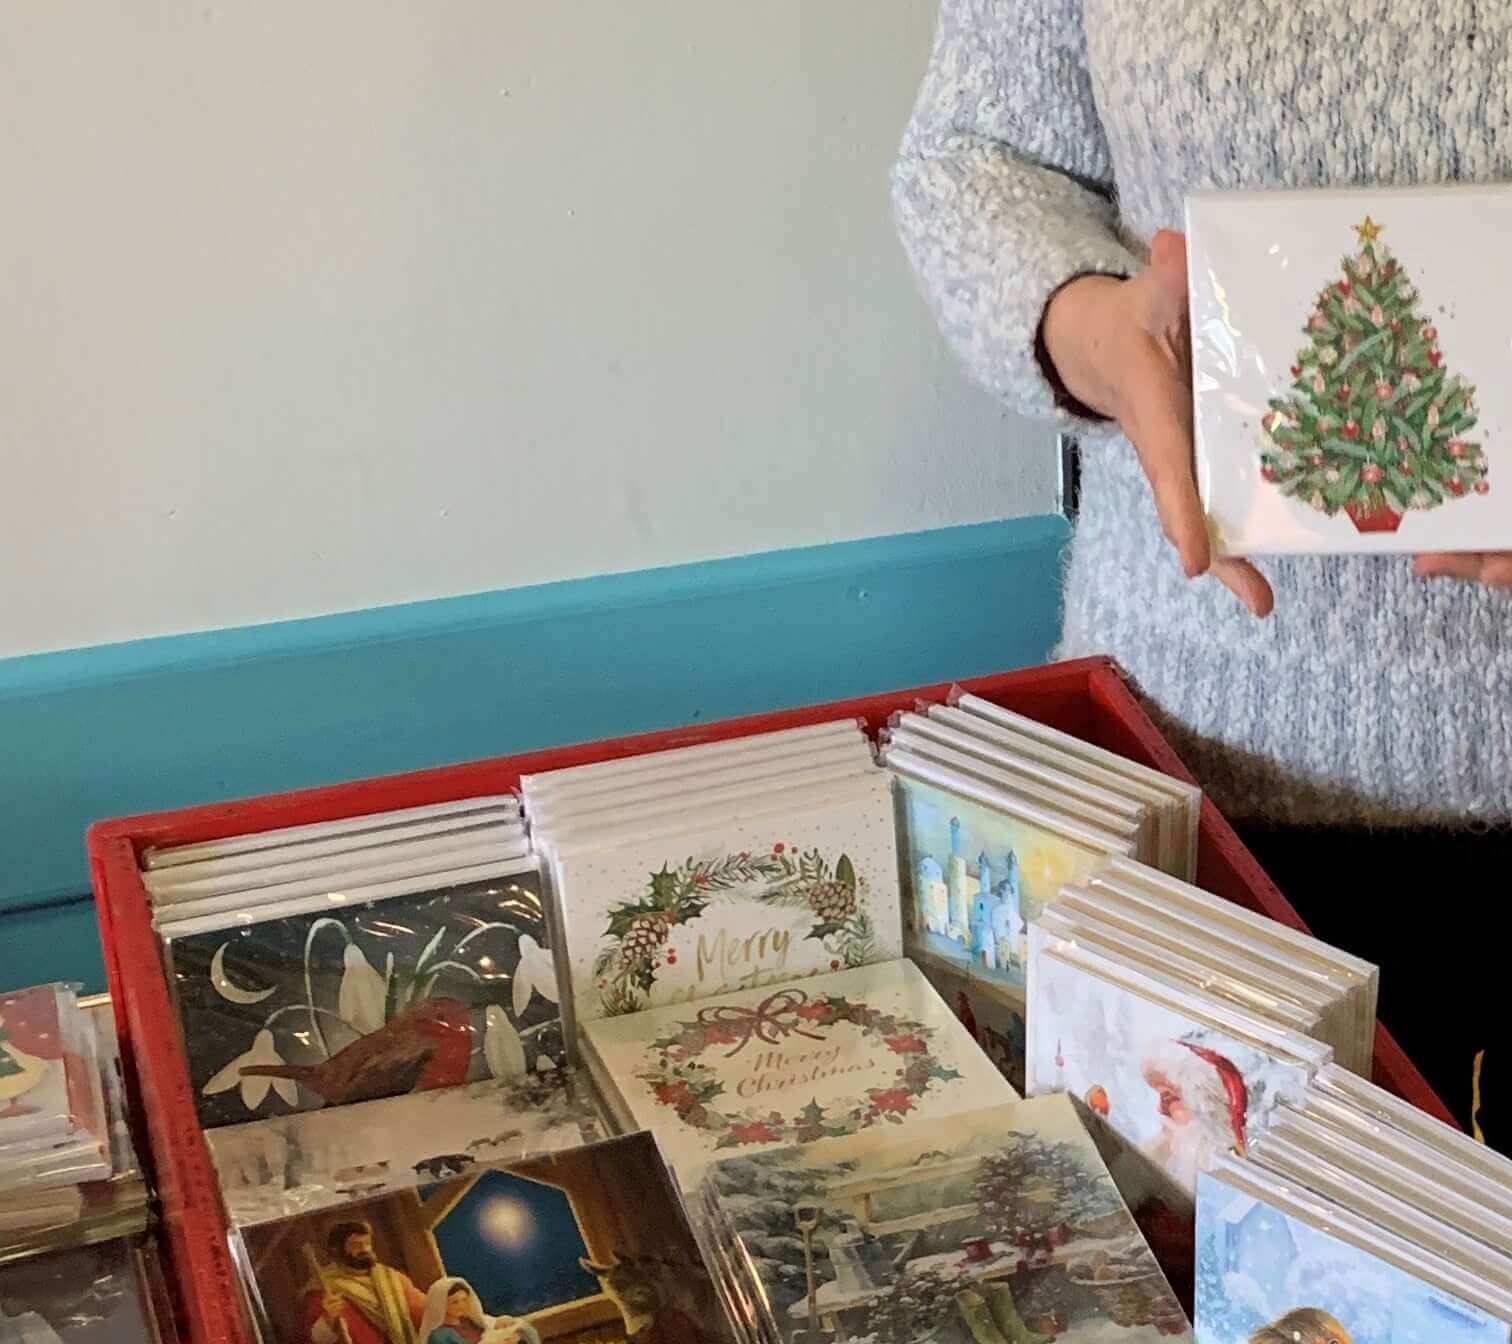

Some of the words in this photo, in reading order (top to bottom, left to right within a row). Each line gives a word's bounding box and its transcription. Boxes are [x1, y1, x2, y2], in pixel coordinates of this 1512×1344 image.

[696, 924, 791, 982] Merry
[735, 1058, 877, 1098] Christmas
[752, 1045, 841, 1073] Merry
